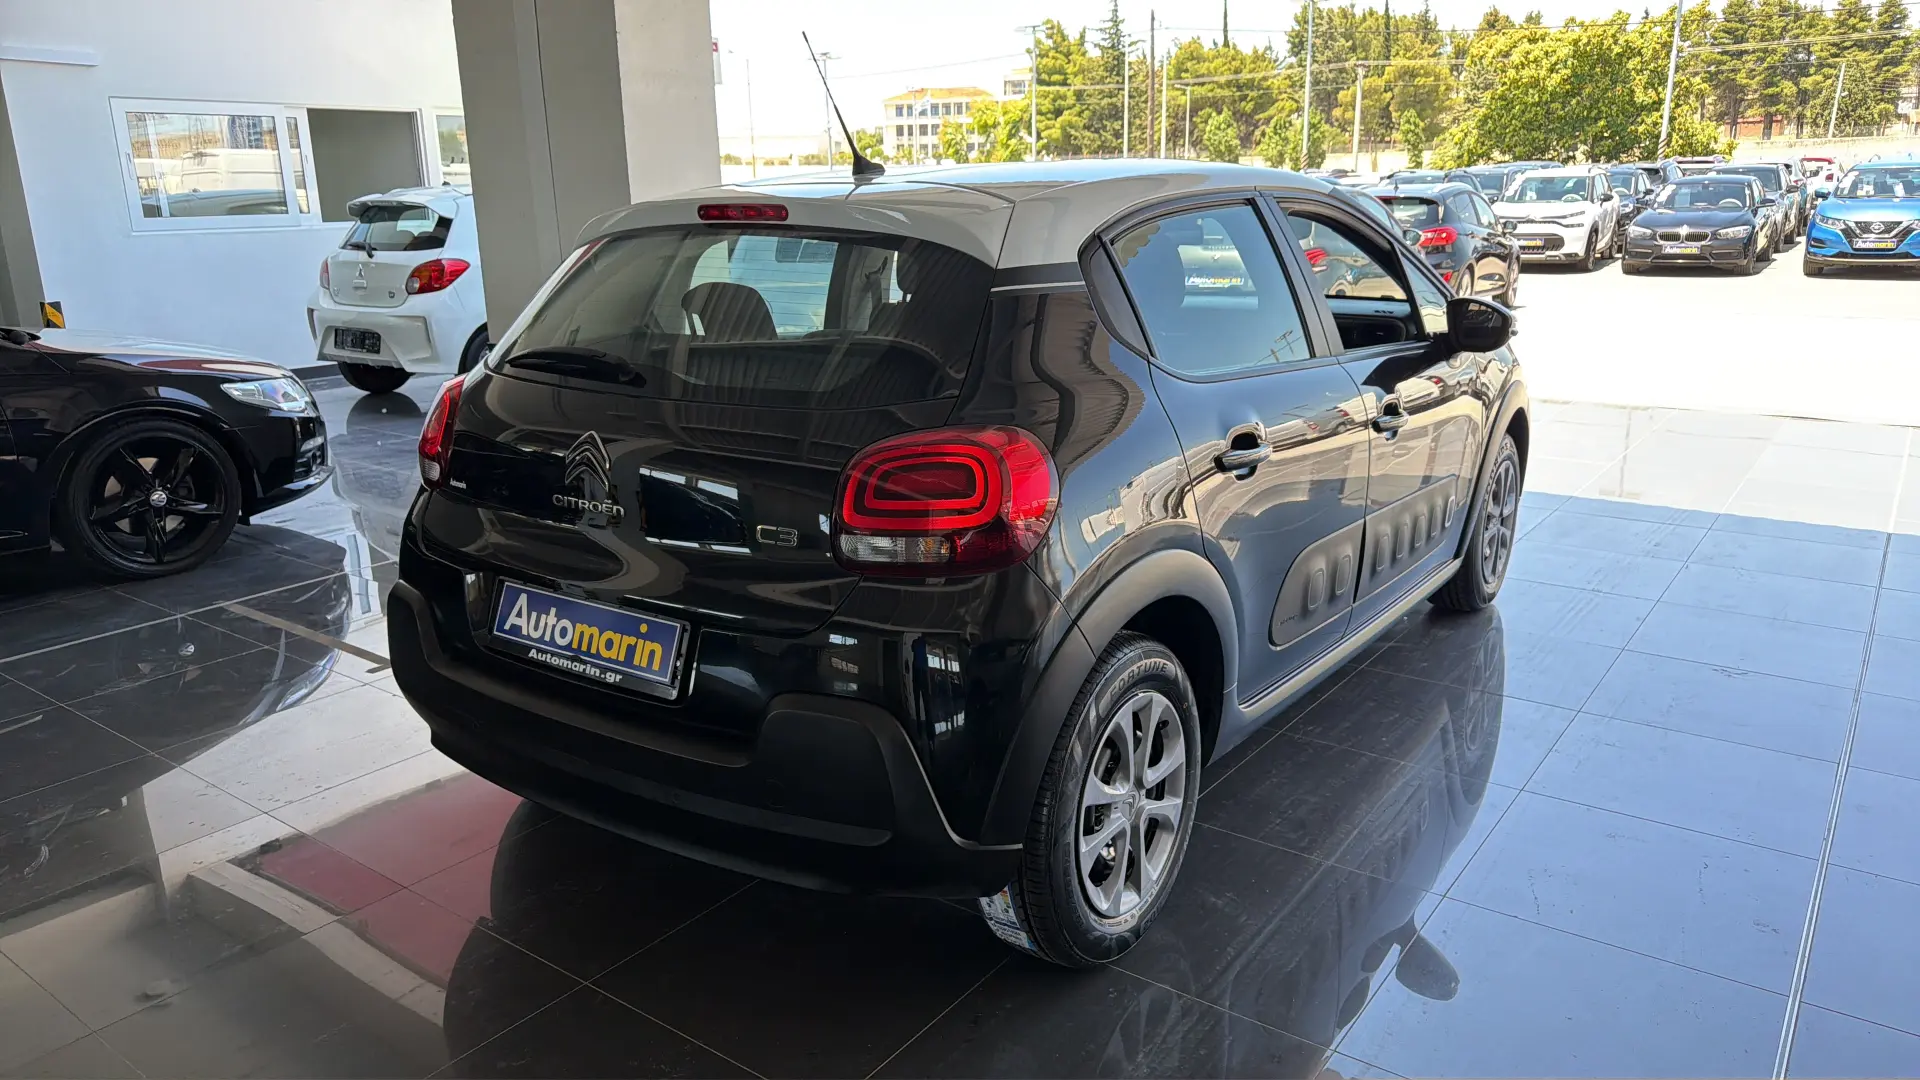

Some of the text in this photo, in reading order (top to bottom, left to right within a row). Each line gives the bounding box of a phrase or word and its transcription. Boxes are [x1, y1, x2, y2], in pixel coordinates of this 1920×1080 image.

[1856, 239, 1894, 248] Automarin
[756, 525, 798, 547] C3
[504, 593, 662, 671] Automarin
[528, 648, 623, 683] Automarin.gr
[1110, 660, 1168, 701] FORTUNE
